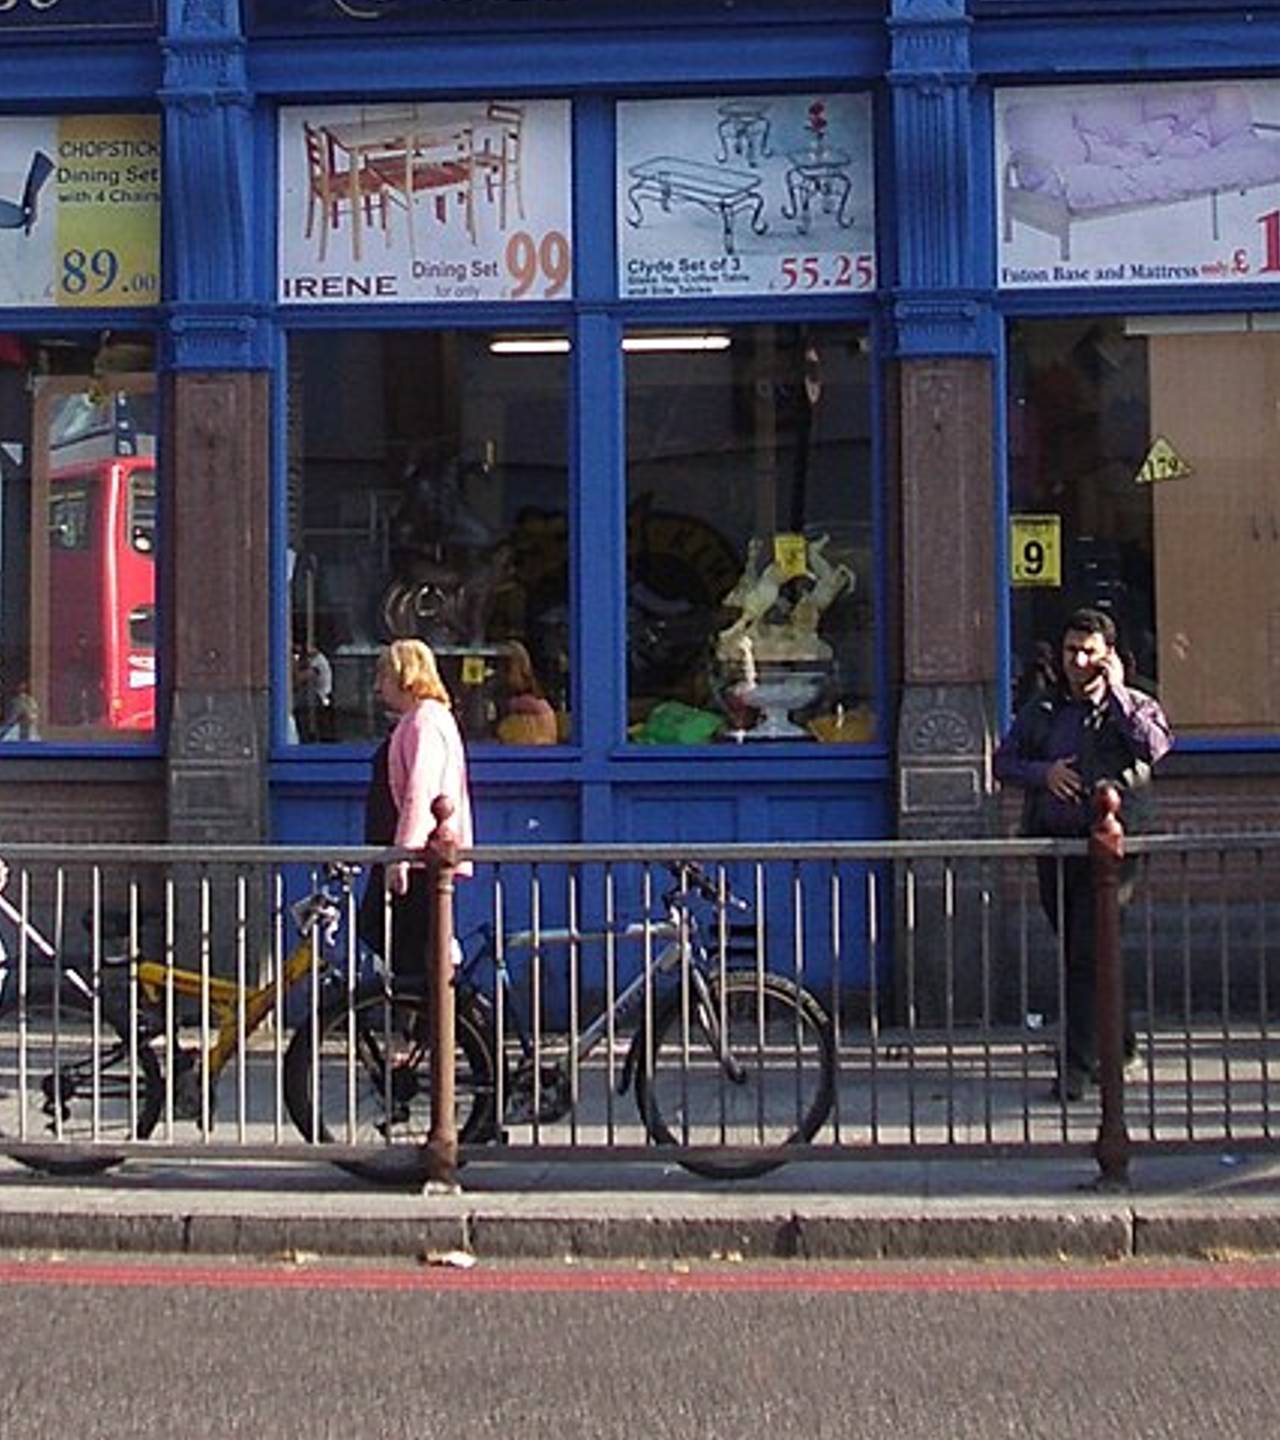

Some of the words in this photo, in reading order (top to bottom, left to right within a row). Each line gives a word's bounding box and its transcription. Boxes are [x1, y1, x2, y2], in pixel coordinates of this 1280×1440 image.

[57, 167, 120, 186] Dining
[126, 165, 159, 183] Set
[58, 189, 92, 203] with
[96, 189, 105, 203] 4
[412, 261, 467, 282] Dining
[472, 261, 499, 278] Set
[679, 258, 705, 272] Set
[1052, 266, 1089, 282] Base
[1094, 264, 1125, 280] and
[1130, 262, 1199, 279] Mattress
[283, 276, 398, 299] IRENE
[1024, 540, 1044, 575] 9
